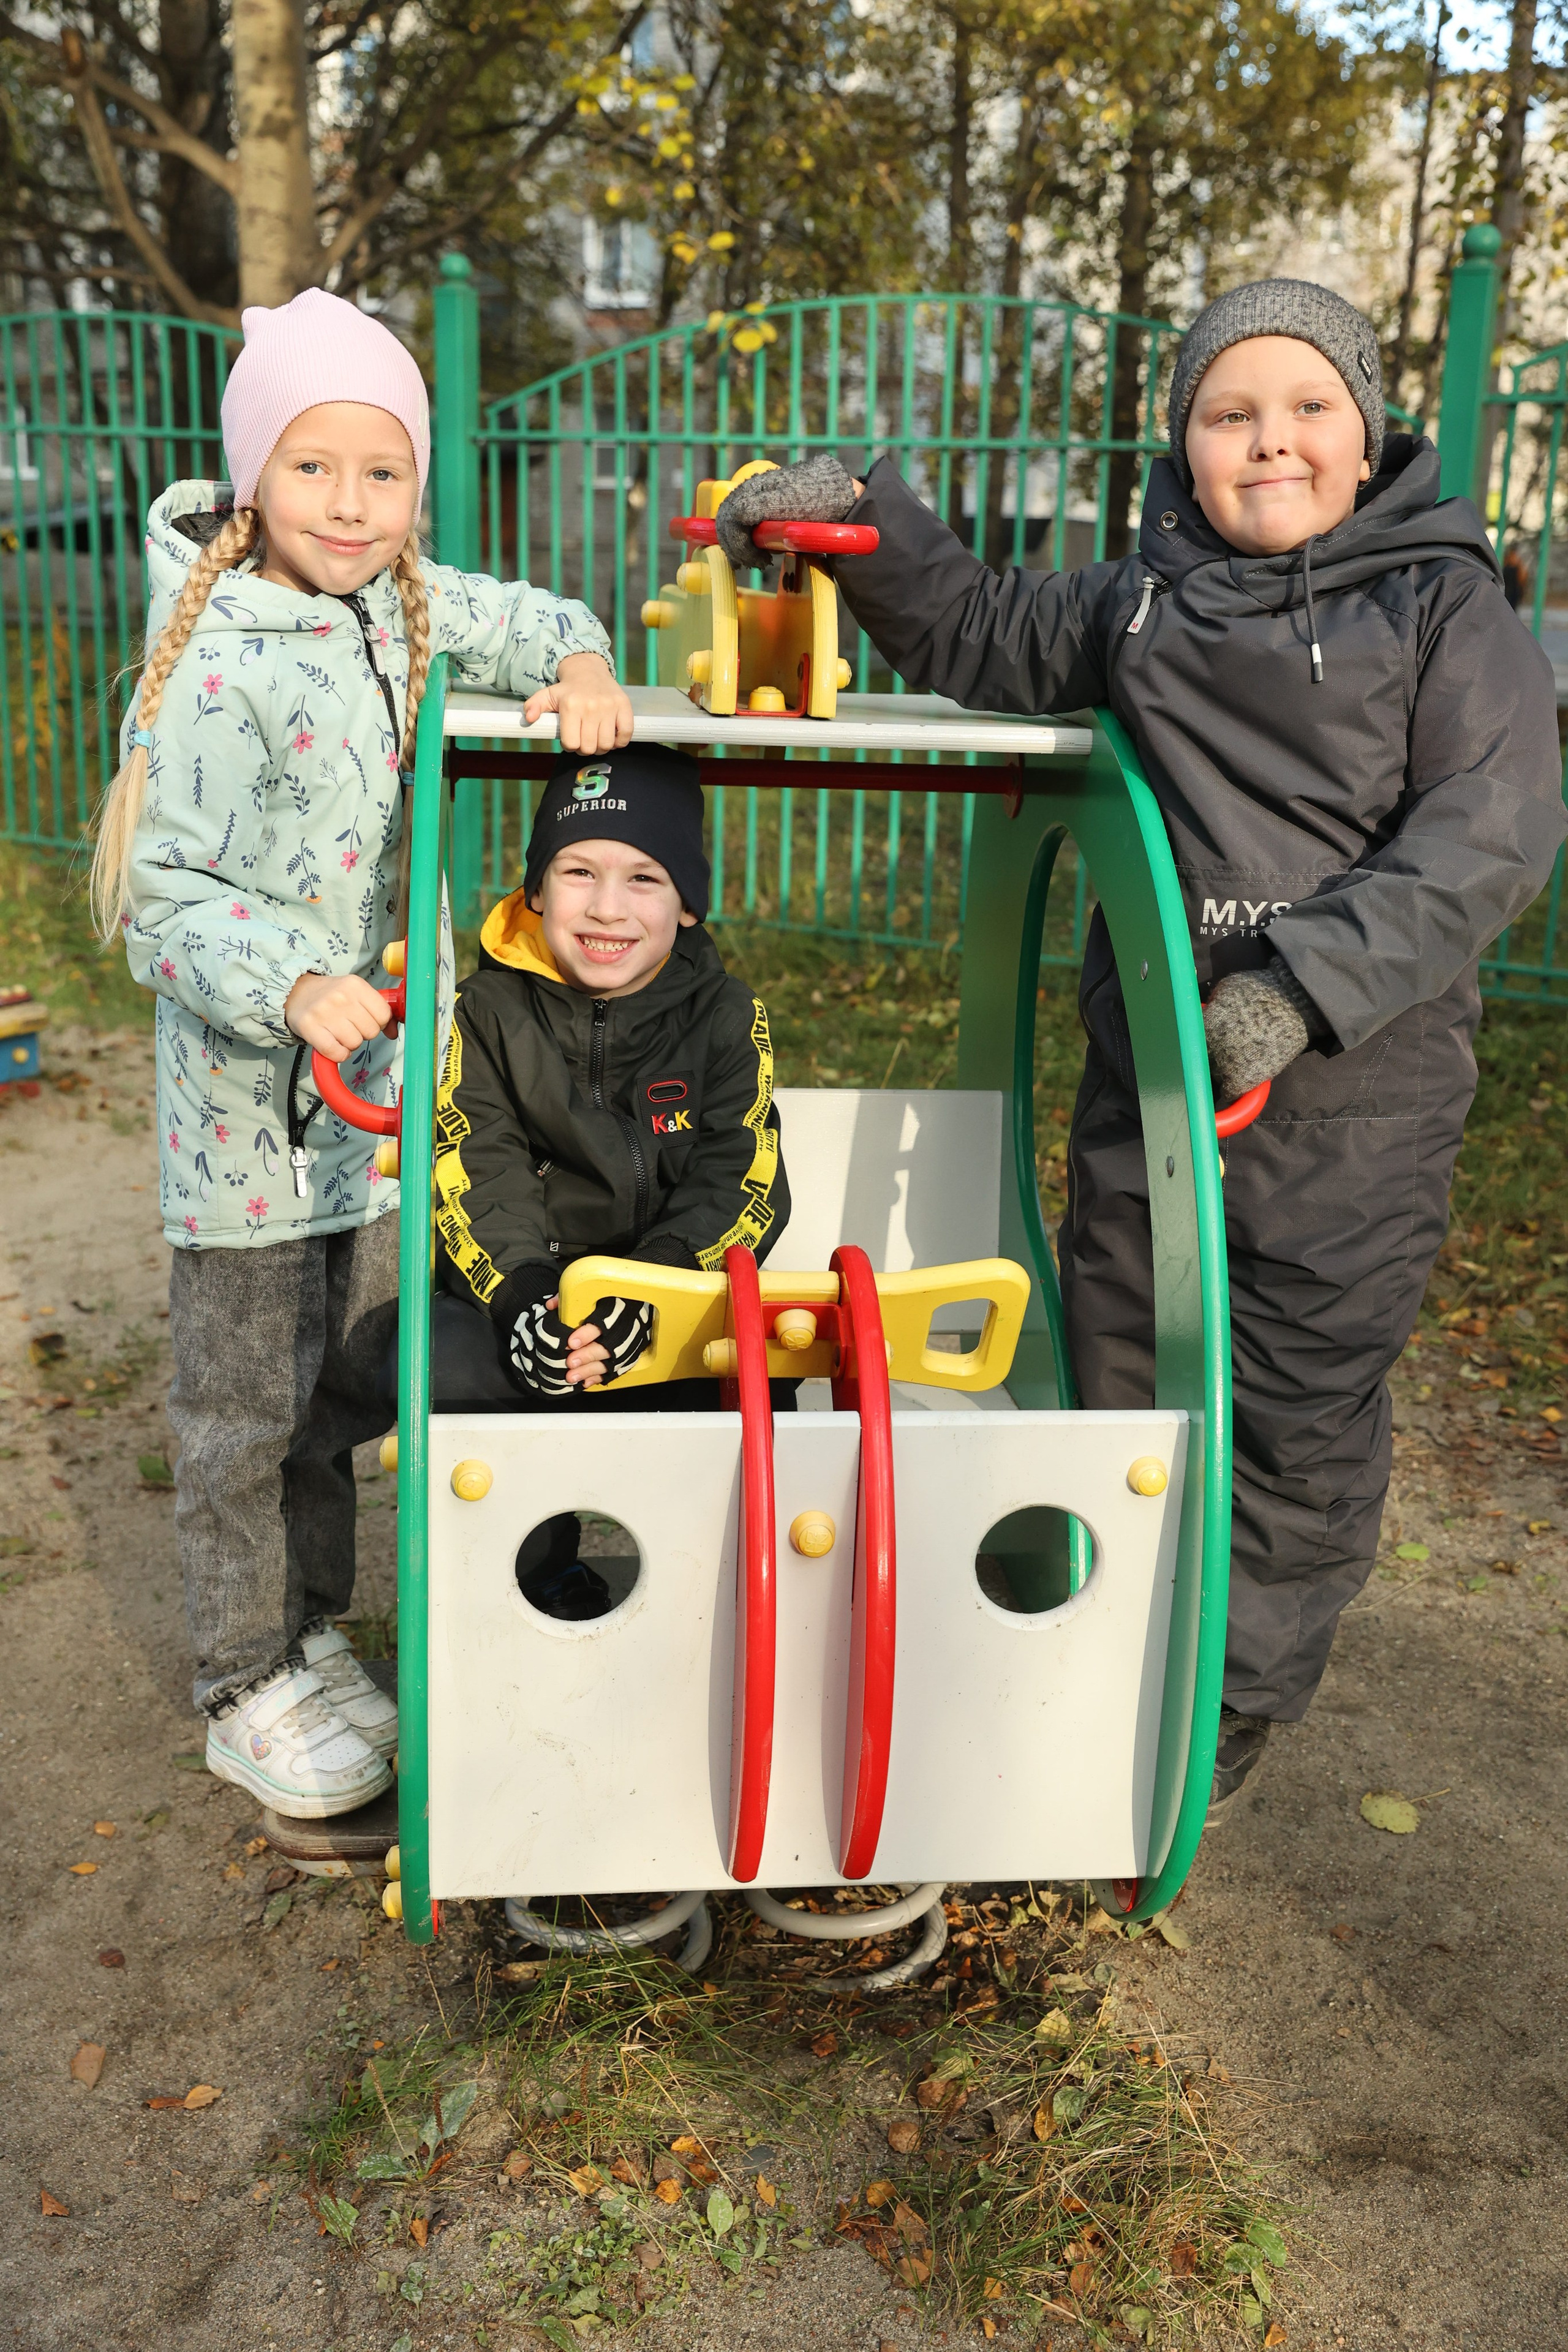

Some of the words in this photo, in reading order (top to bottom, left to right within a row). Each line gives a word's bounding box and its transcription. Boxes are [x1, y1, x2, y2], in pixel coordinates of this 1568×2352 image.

[571, 763, 612, 801] S
[557, 798, 627, 821] SUPERIOR
[1200, 926, 1228, 937] MYS
[753, 1004, 772, 1059] MADE
[651, 1109, 693, 1135] K&K
